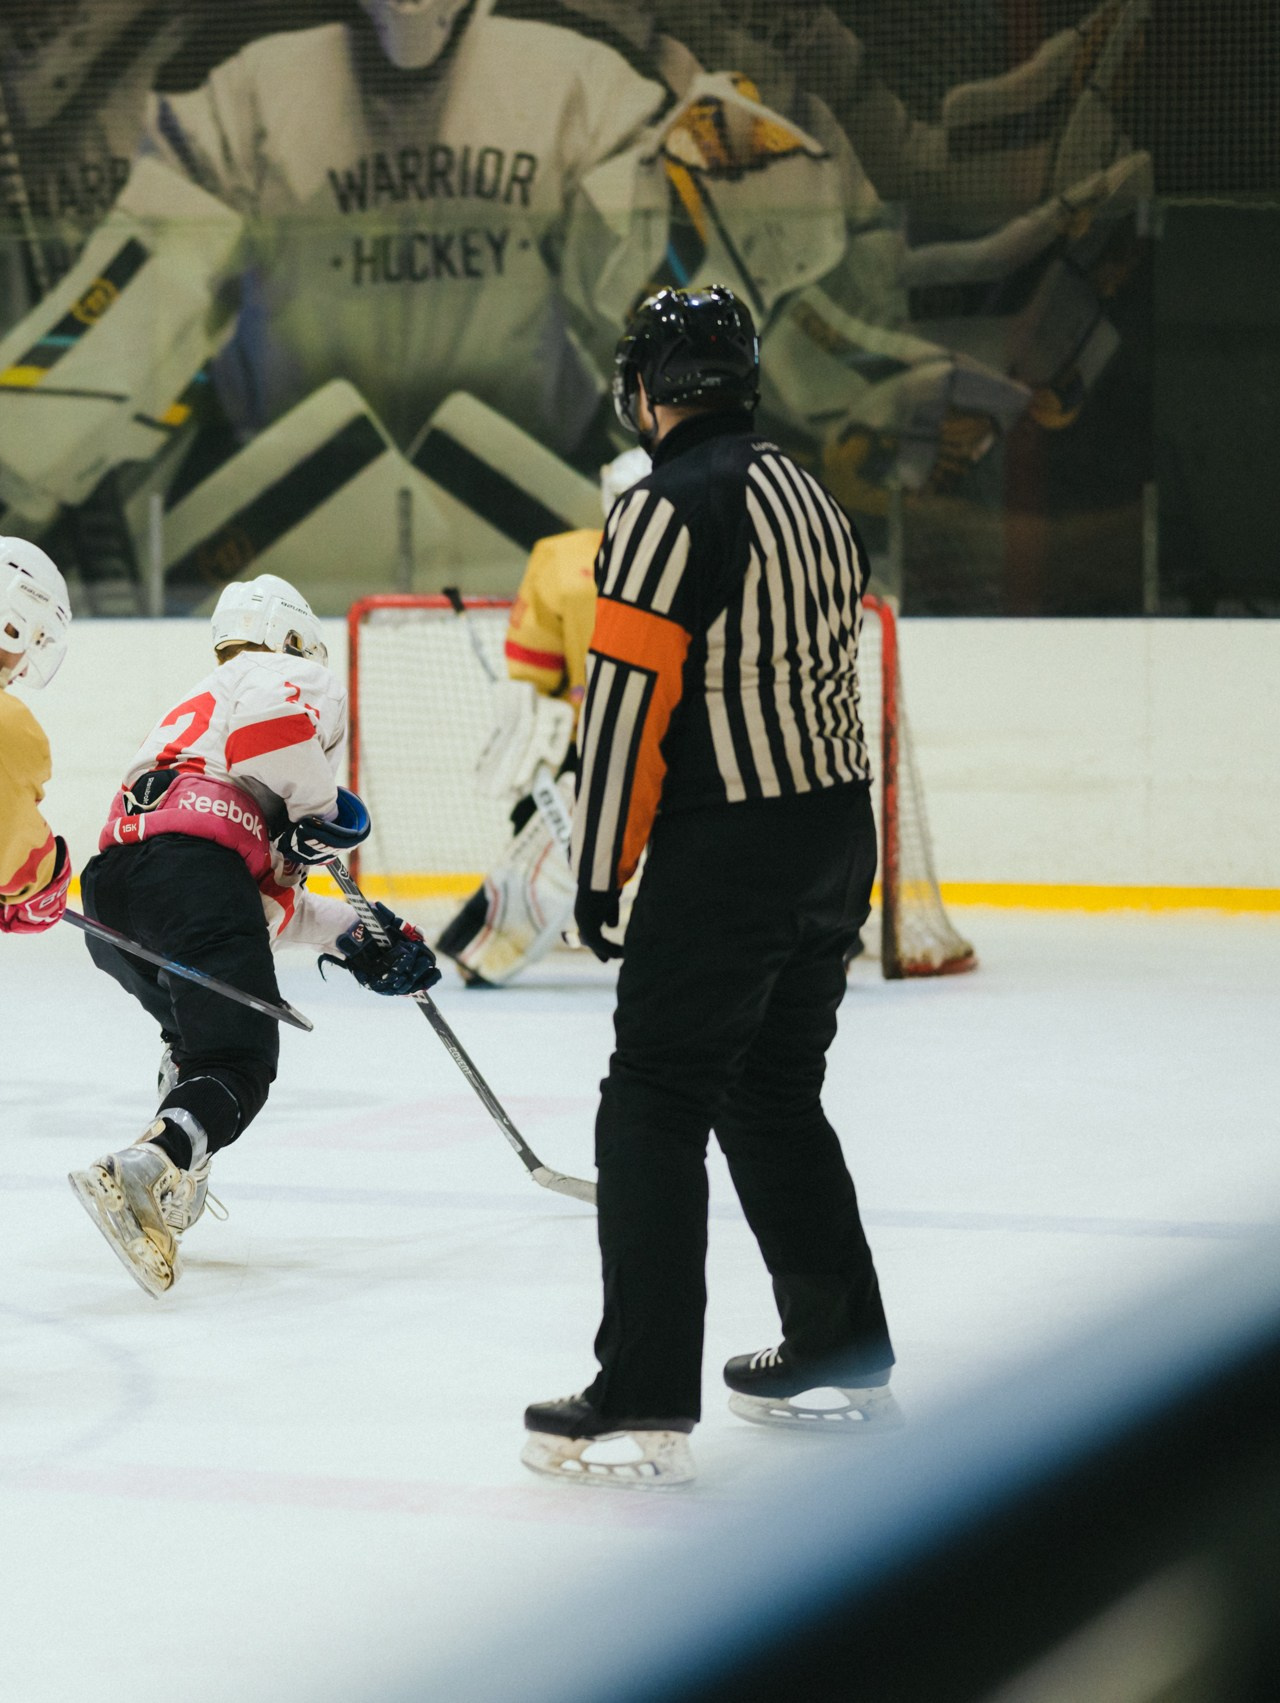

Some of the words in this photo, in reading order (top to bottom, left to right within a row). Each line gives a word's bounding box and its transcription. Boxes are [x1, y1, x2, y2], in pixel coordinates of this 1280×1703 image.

[327, 144, 538, 214] WARRIOR
[352, 227, 510, 286] HOCKEY
[178, 791, 263, 841] Reebok
